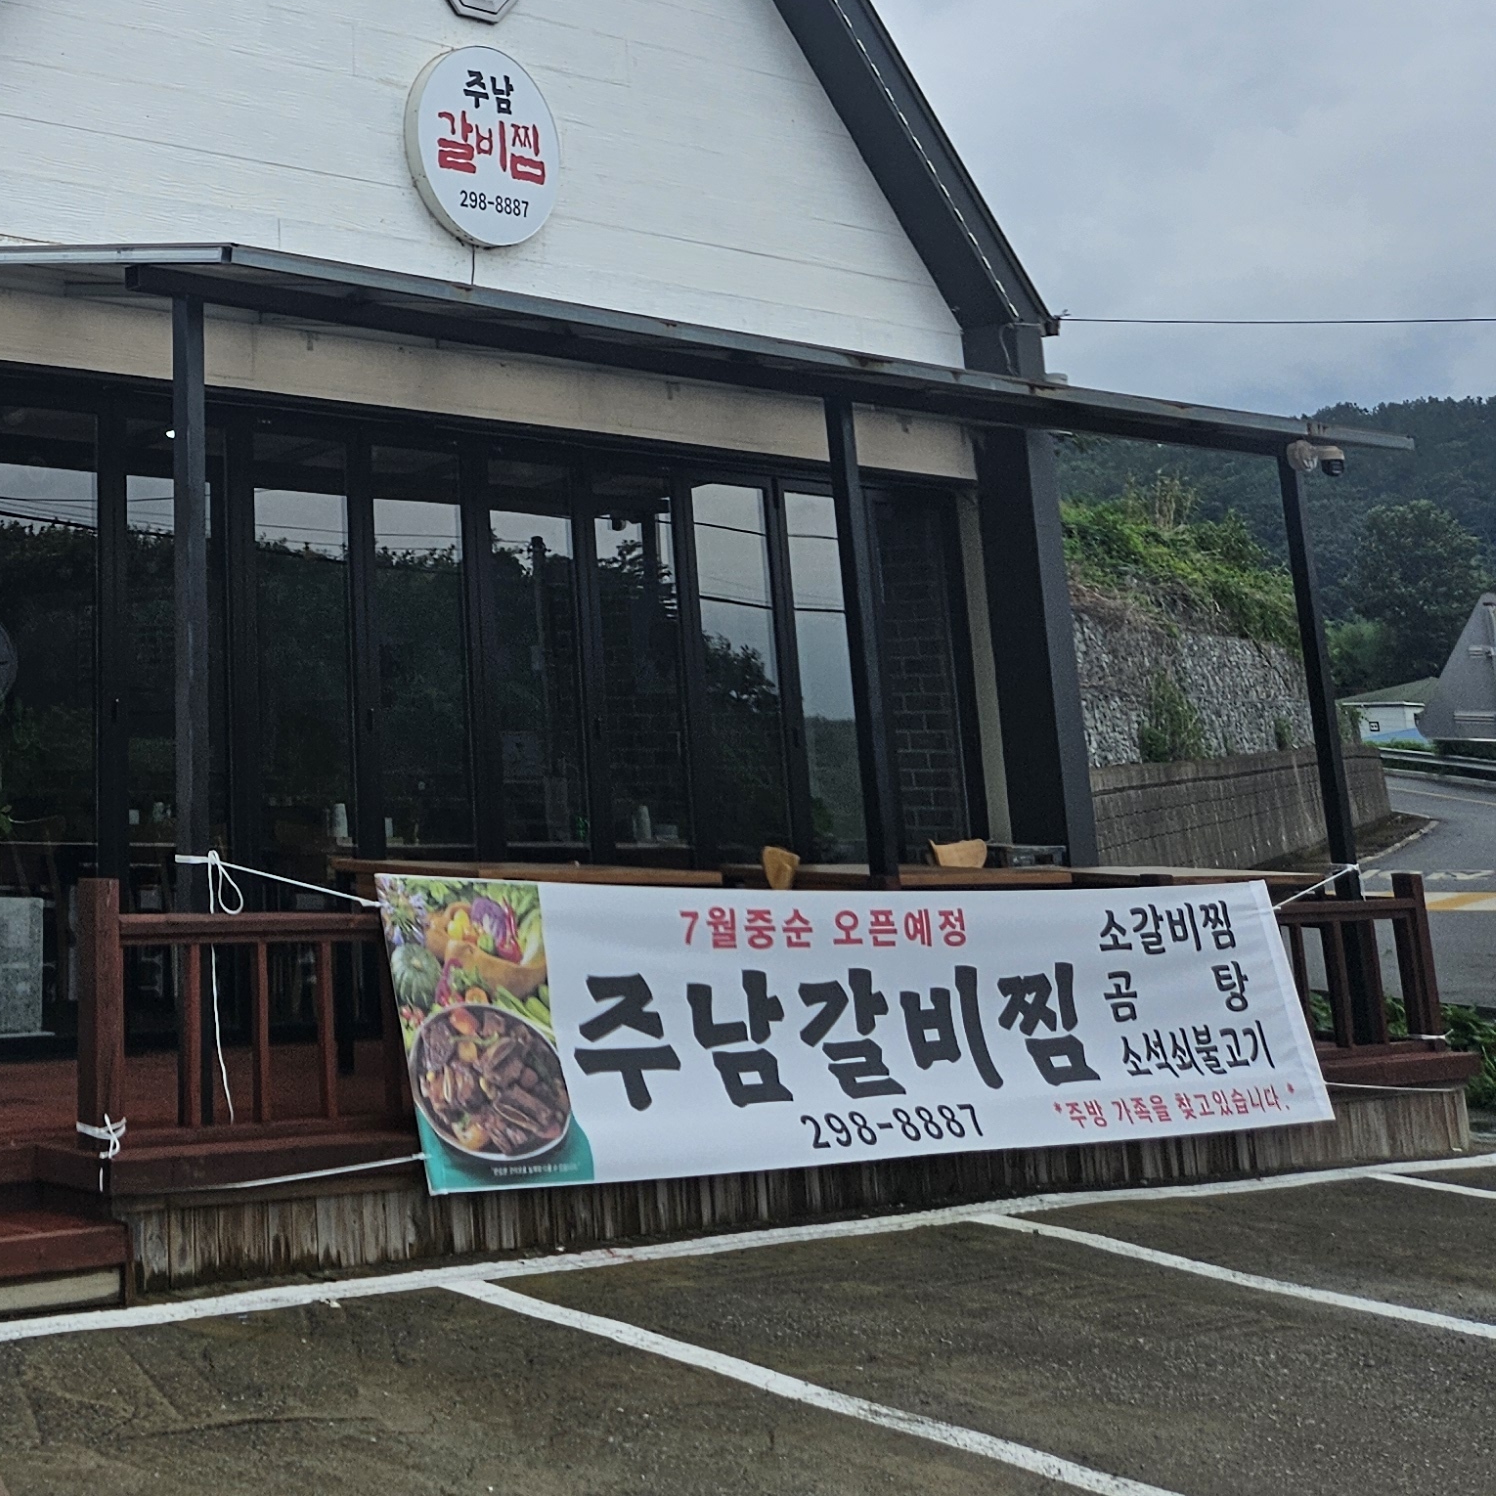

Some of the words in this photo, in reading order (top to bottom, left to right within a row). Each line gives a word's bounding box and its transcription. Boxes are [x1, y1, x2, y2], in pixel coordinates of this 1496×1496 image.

[462, 69, 515, 116] 주남
[436, 109, 546, 186] 갈비찜
[459, 189, 530, 218] 298-8887
[678, 906, 815, 950] 7월중순
[832, 907, 969, 949] 오픈예정
[1098, 898, 1238, 956] 소갈비찜
[573, 961, 1101, 1112] 주남갈비찜
[1120, 1018, 1277, 1079] 소석쇠불고기
[799, 1102, 984, 1150] 298-8887
[1110, 1094, 1173, 1126] 가족을
